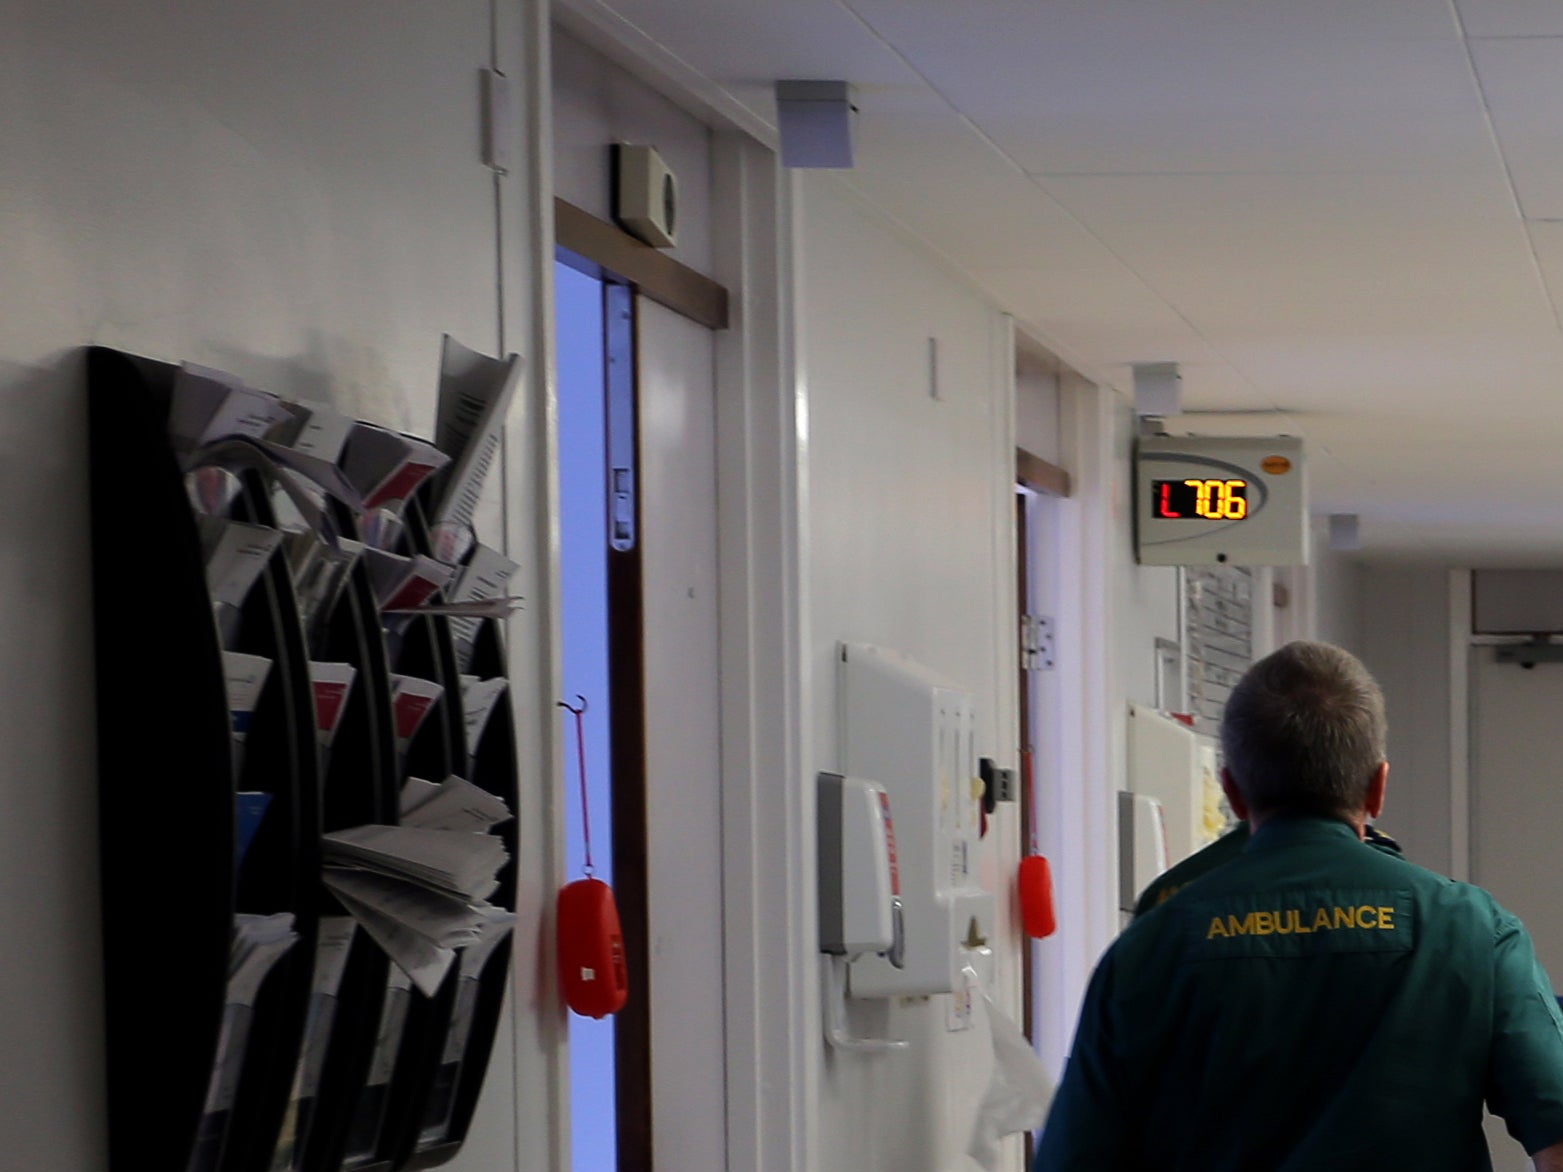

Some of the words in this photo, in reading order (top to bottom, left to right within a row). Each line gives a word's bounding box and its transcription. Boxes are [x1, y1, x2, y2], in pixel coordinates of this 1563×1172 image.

[1161, 483, 1181, 517] L
[1184, 480, 1246, 518] 706
[1207, 906, 1395, 939] AMBULANCE
